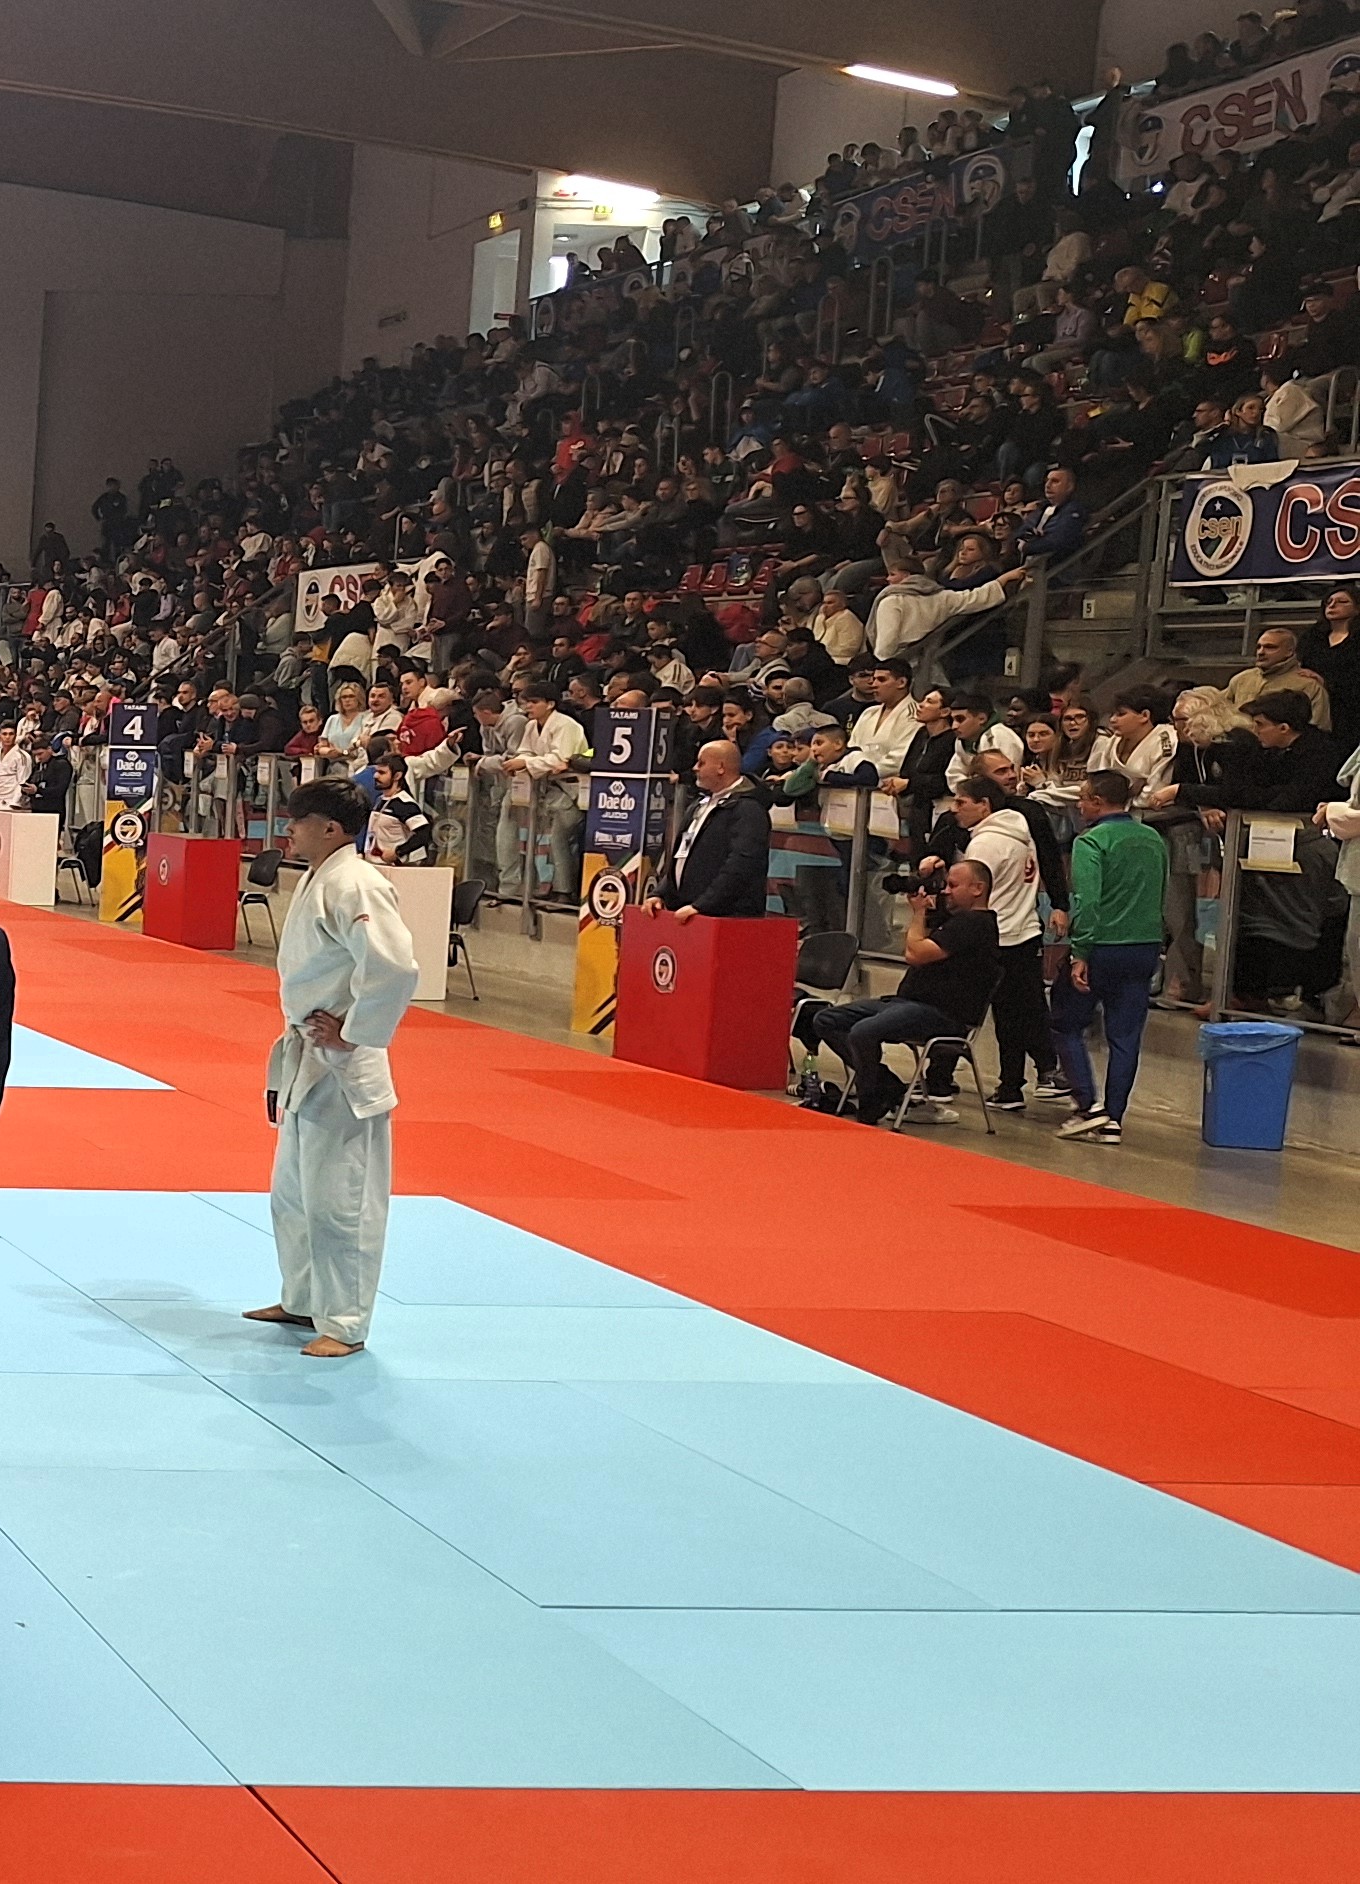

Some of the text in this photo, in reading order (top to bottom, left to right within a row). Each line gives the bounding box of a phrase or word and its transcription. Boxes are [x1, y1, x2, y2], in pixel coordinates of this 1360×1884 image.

[1181, 69, 1308, 153] CSEN
[867, 172, 957, 241] CSEN
[1198, 515, 1243, 540] csen
[1086, 603, 1092, 613] 5
[1007, 661, 1013, 671] 4
[122, 715, 144, 741] 4
[610, 711, 639, 720] TATAMI
[609, 726, 633, 765] 5
[656, 727, 668, 766] 5
